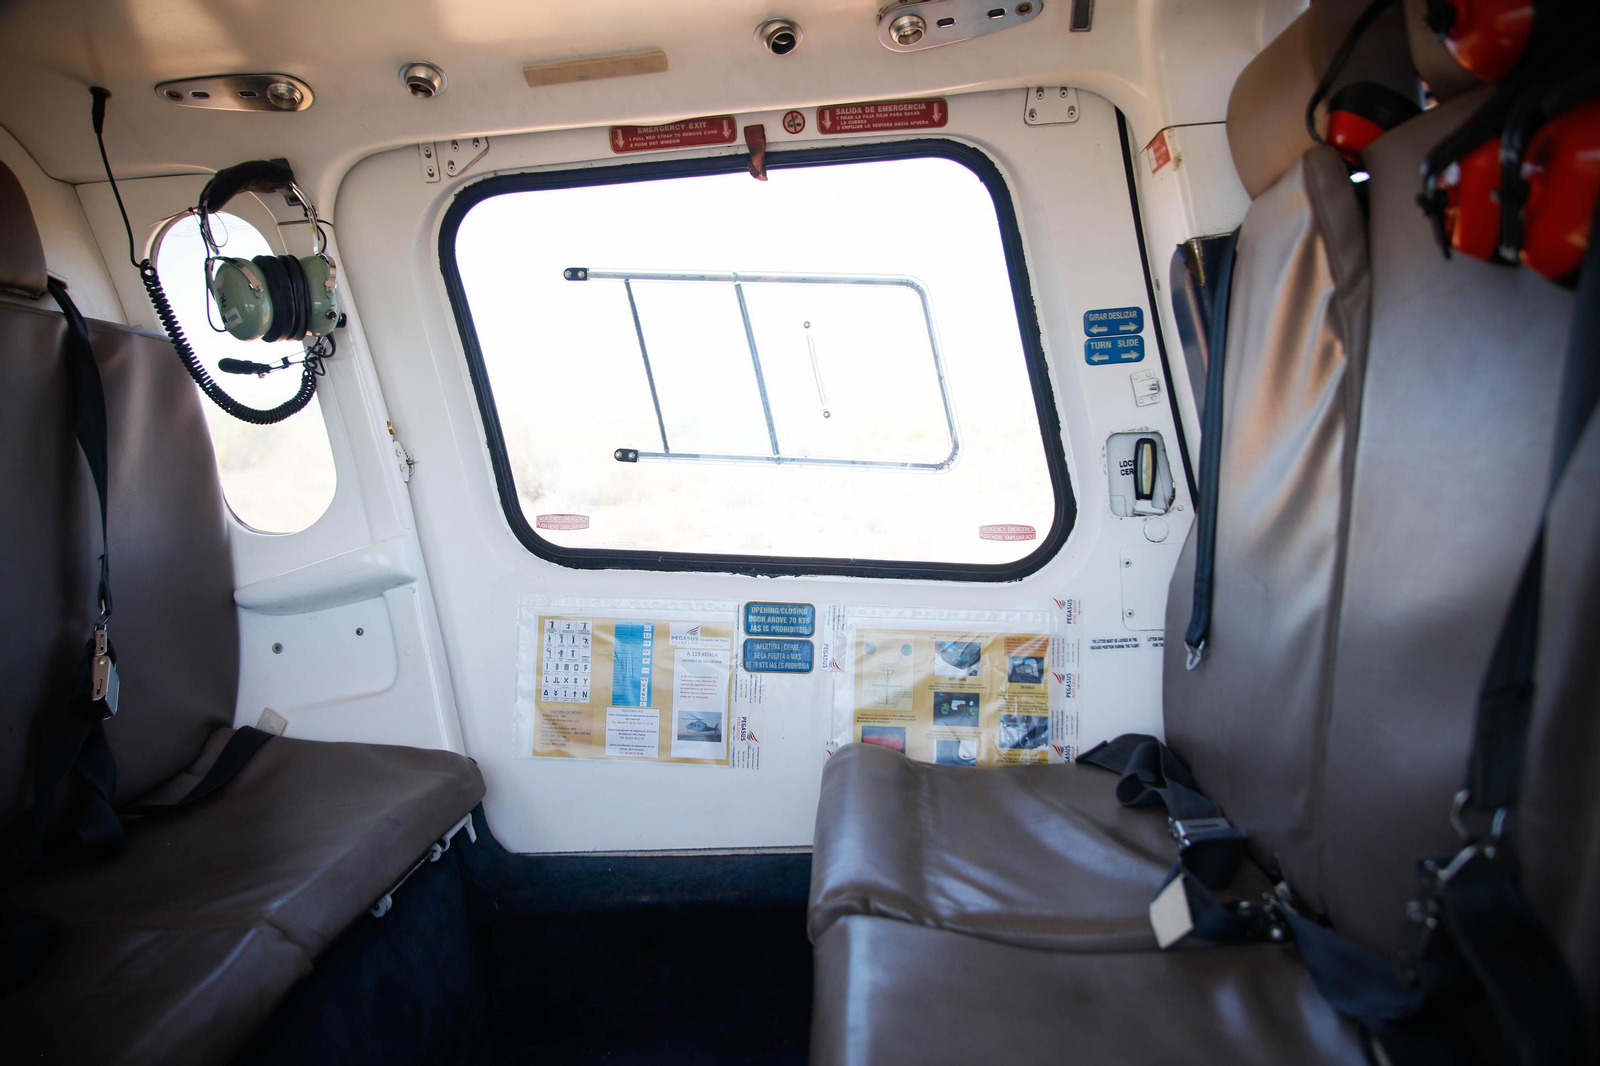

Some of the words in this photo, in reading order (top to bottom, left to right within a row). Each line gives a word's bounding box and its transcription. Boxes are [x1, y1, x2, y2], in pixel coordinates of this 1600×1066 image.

[878, 103, 926, 112] EMERGENCIA
[638, 123, 685, 133] EMERGENCY
[1109, 311, 1137, 319] DESLIZAR
[1090, 341, 1111, 349] TURN
[1117, 339, 1139, 347] SLIDE
[752, 607, 807, 615] OPENING/CLOSING
